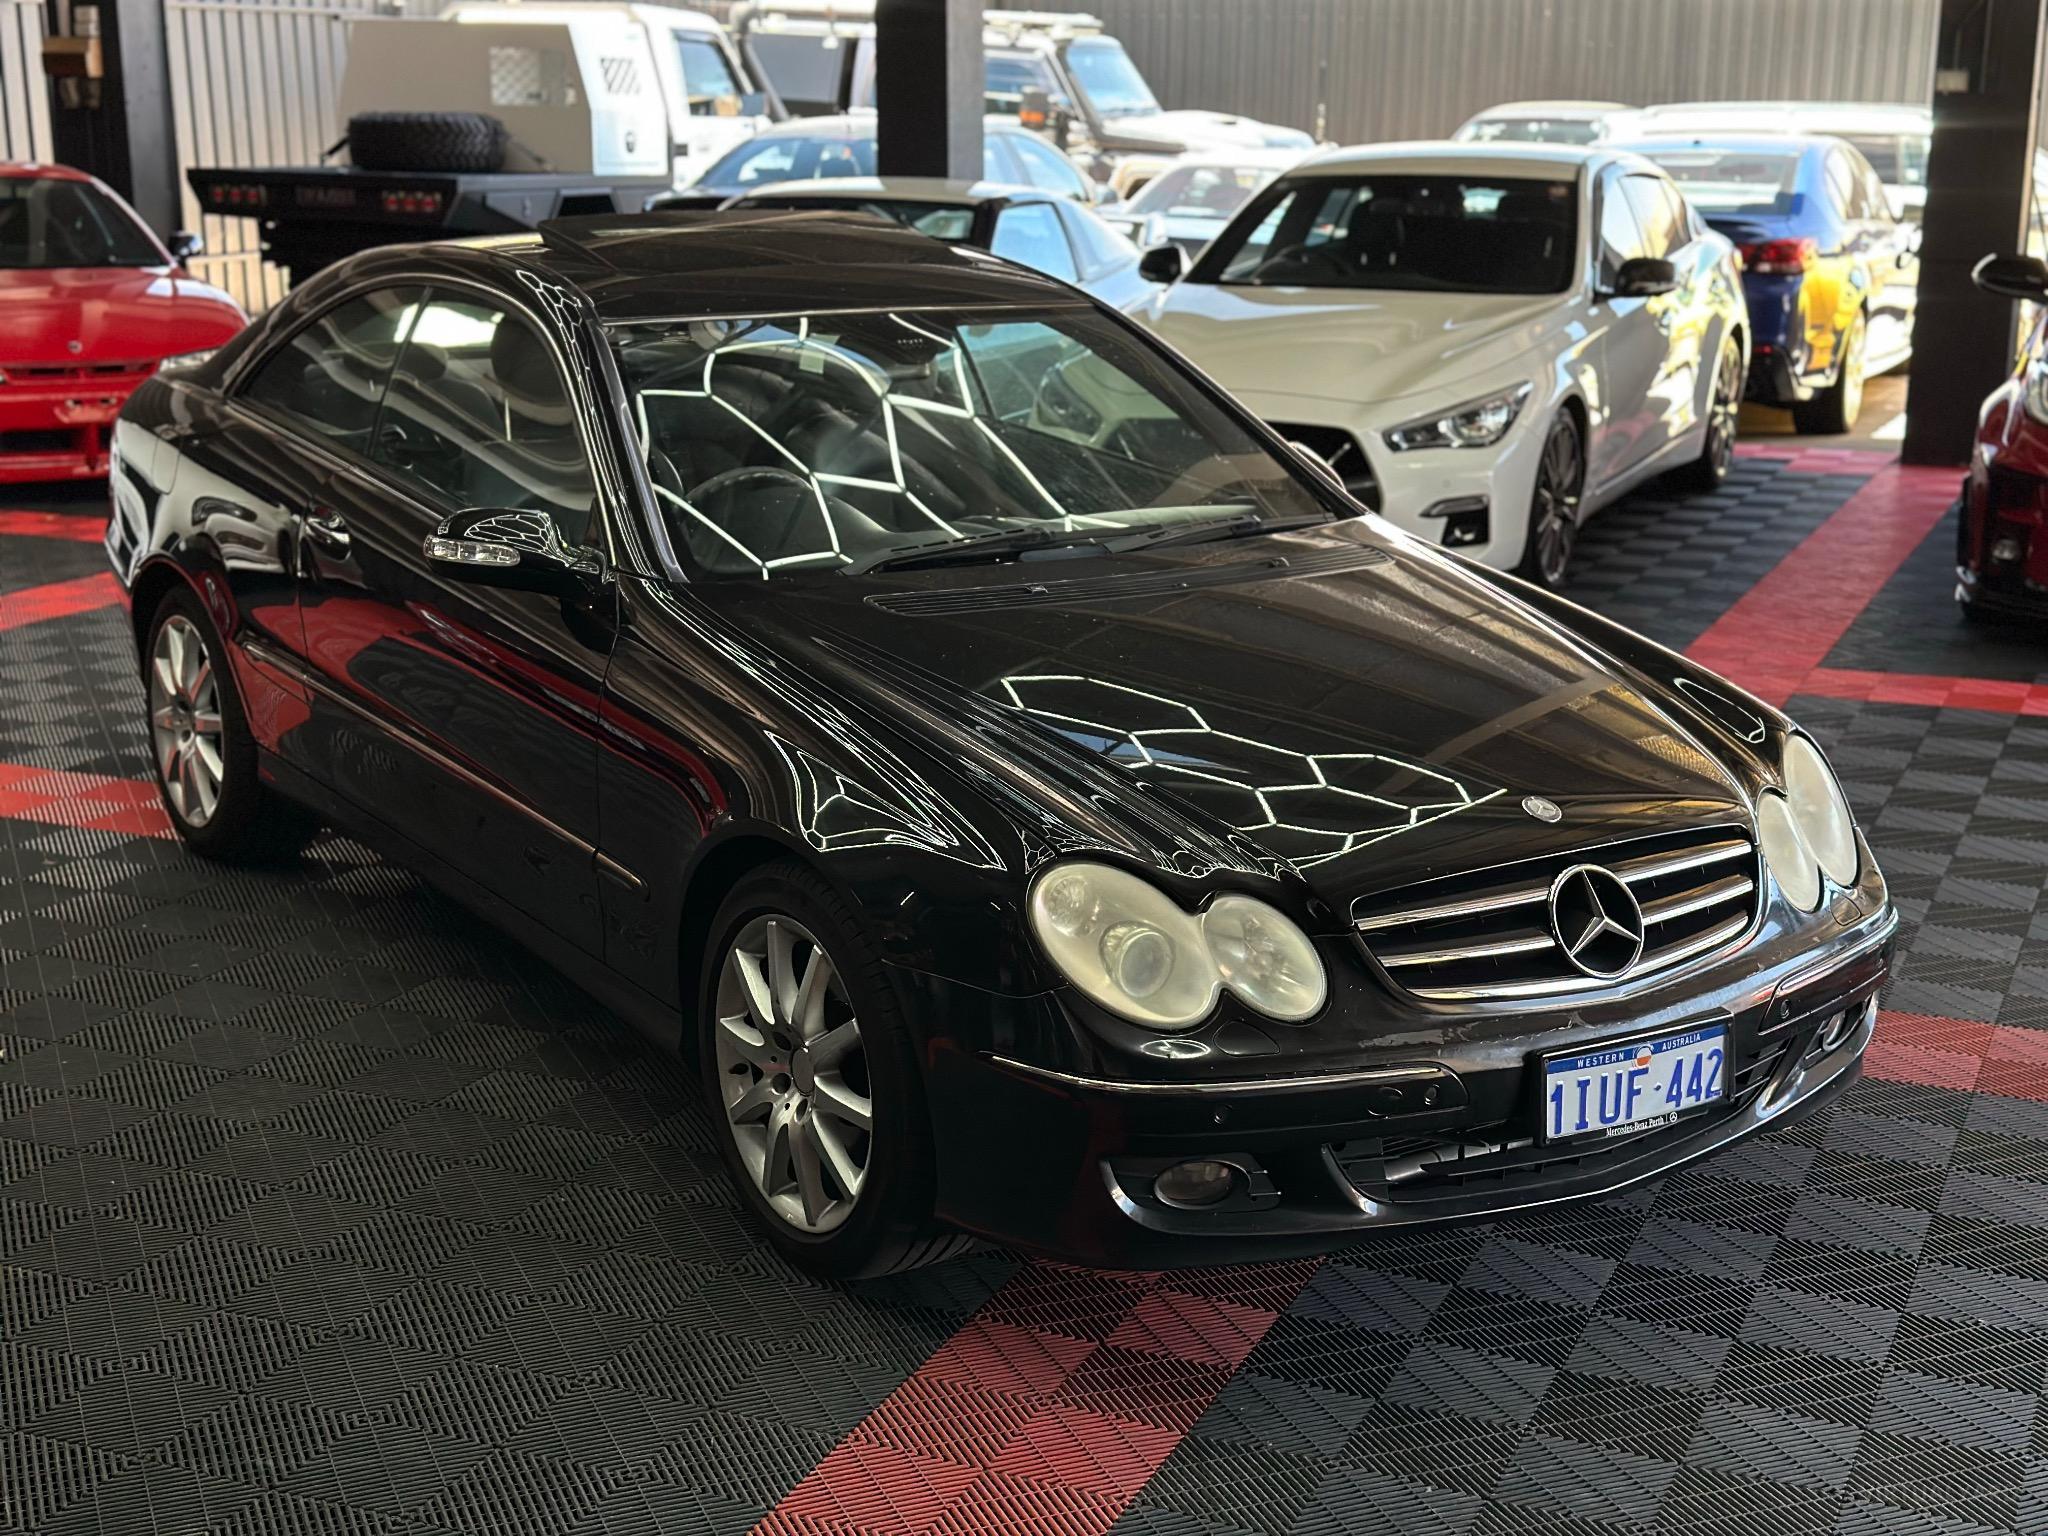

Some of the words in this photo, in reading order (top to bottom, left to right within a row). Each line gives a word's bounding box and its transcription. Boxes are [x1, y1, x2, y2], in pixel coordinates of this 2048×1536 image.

[1577, 1051, 1625, 1069] WESTERN
[1662, 1033, 1701, 1051] AUSTRALIA
[1606, 1121, 1648, 1137] Mercedes-Benz
[1648, 1115, 1664, 1127] Perth
